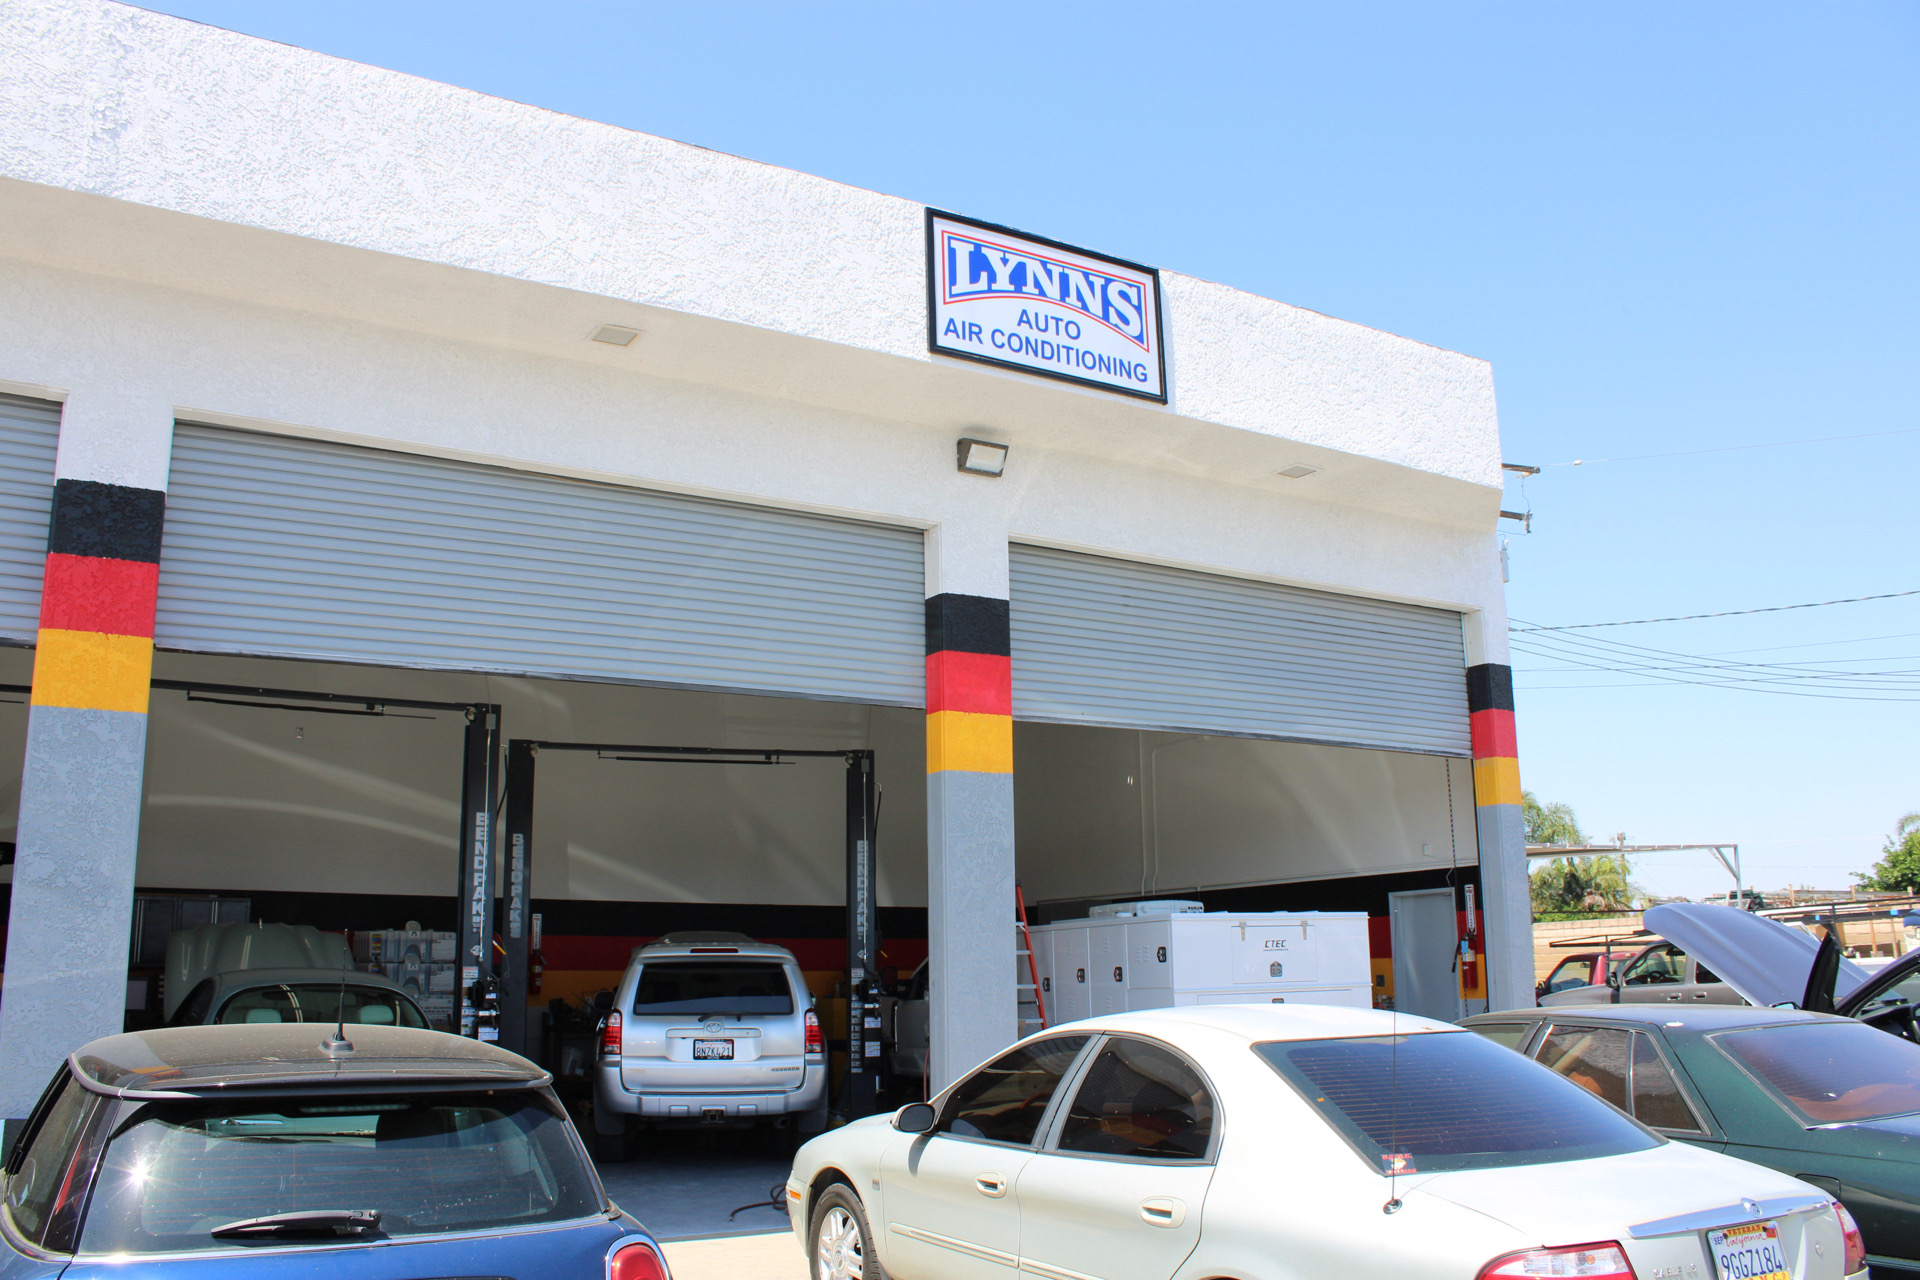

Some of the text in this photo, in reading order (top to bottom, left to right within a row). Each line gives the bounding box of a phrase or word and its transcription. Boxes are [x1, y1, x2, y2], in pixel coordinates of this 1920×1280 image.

[950, 238, 1142, 338] LYNNS
[1017, 309, 1081, 341] AUTO
[943, 317, 1148, 383] AIR CONDITIONING
[1264, 939, 1287, 948] CTEC
[1713, 1236, 1723, 1245] SEP
[1725, 1233, 1768, 1248] California
[1726, 1224, 1761, 1236] VETERAN
[1720, 1244, 1783, 1280] 9GGZ184
